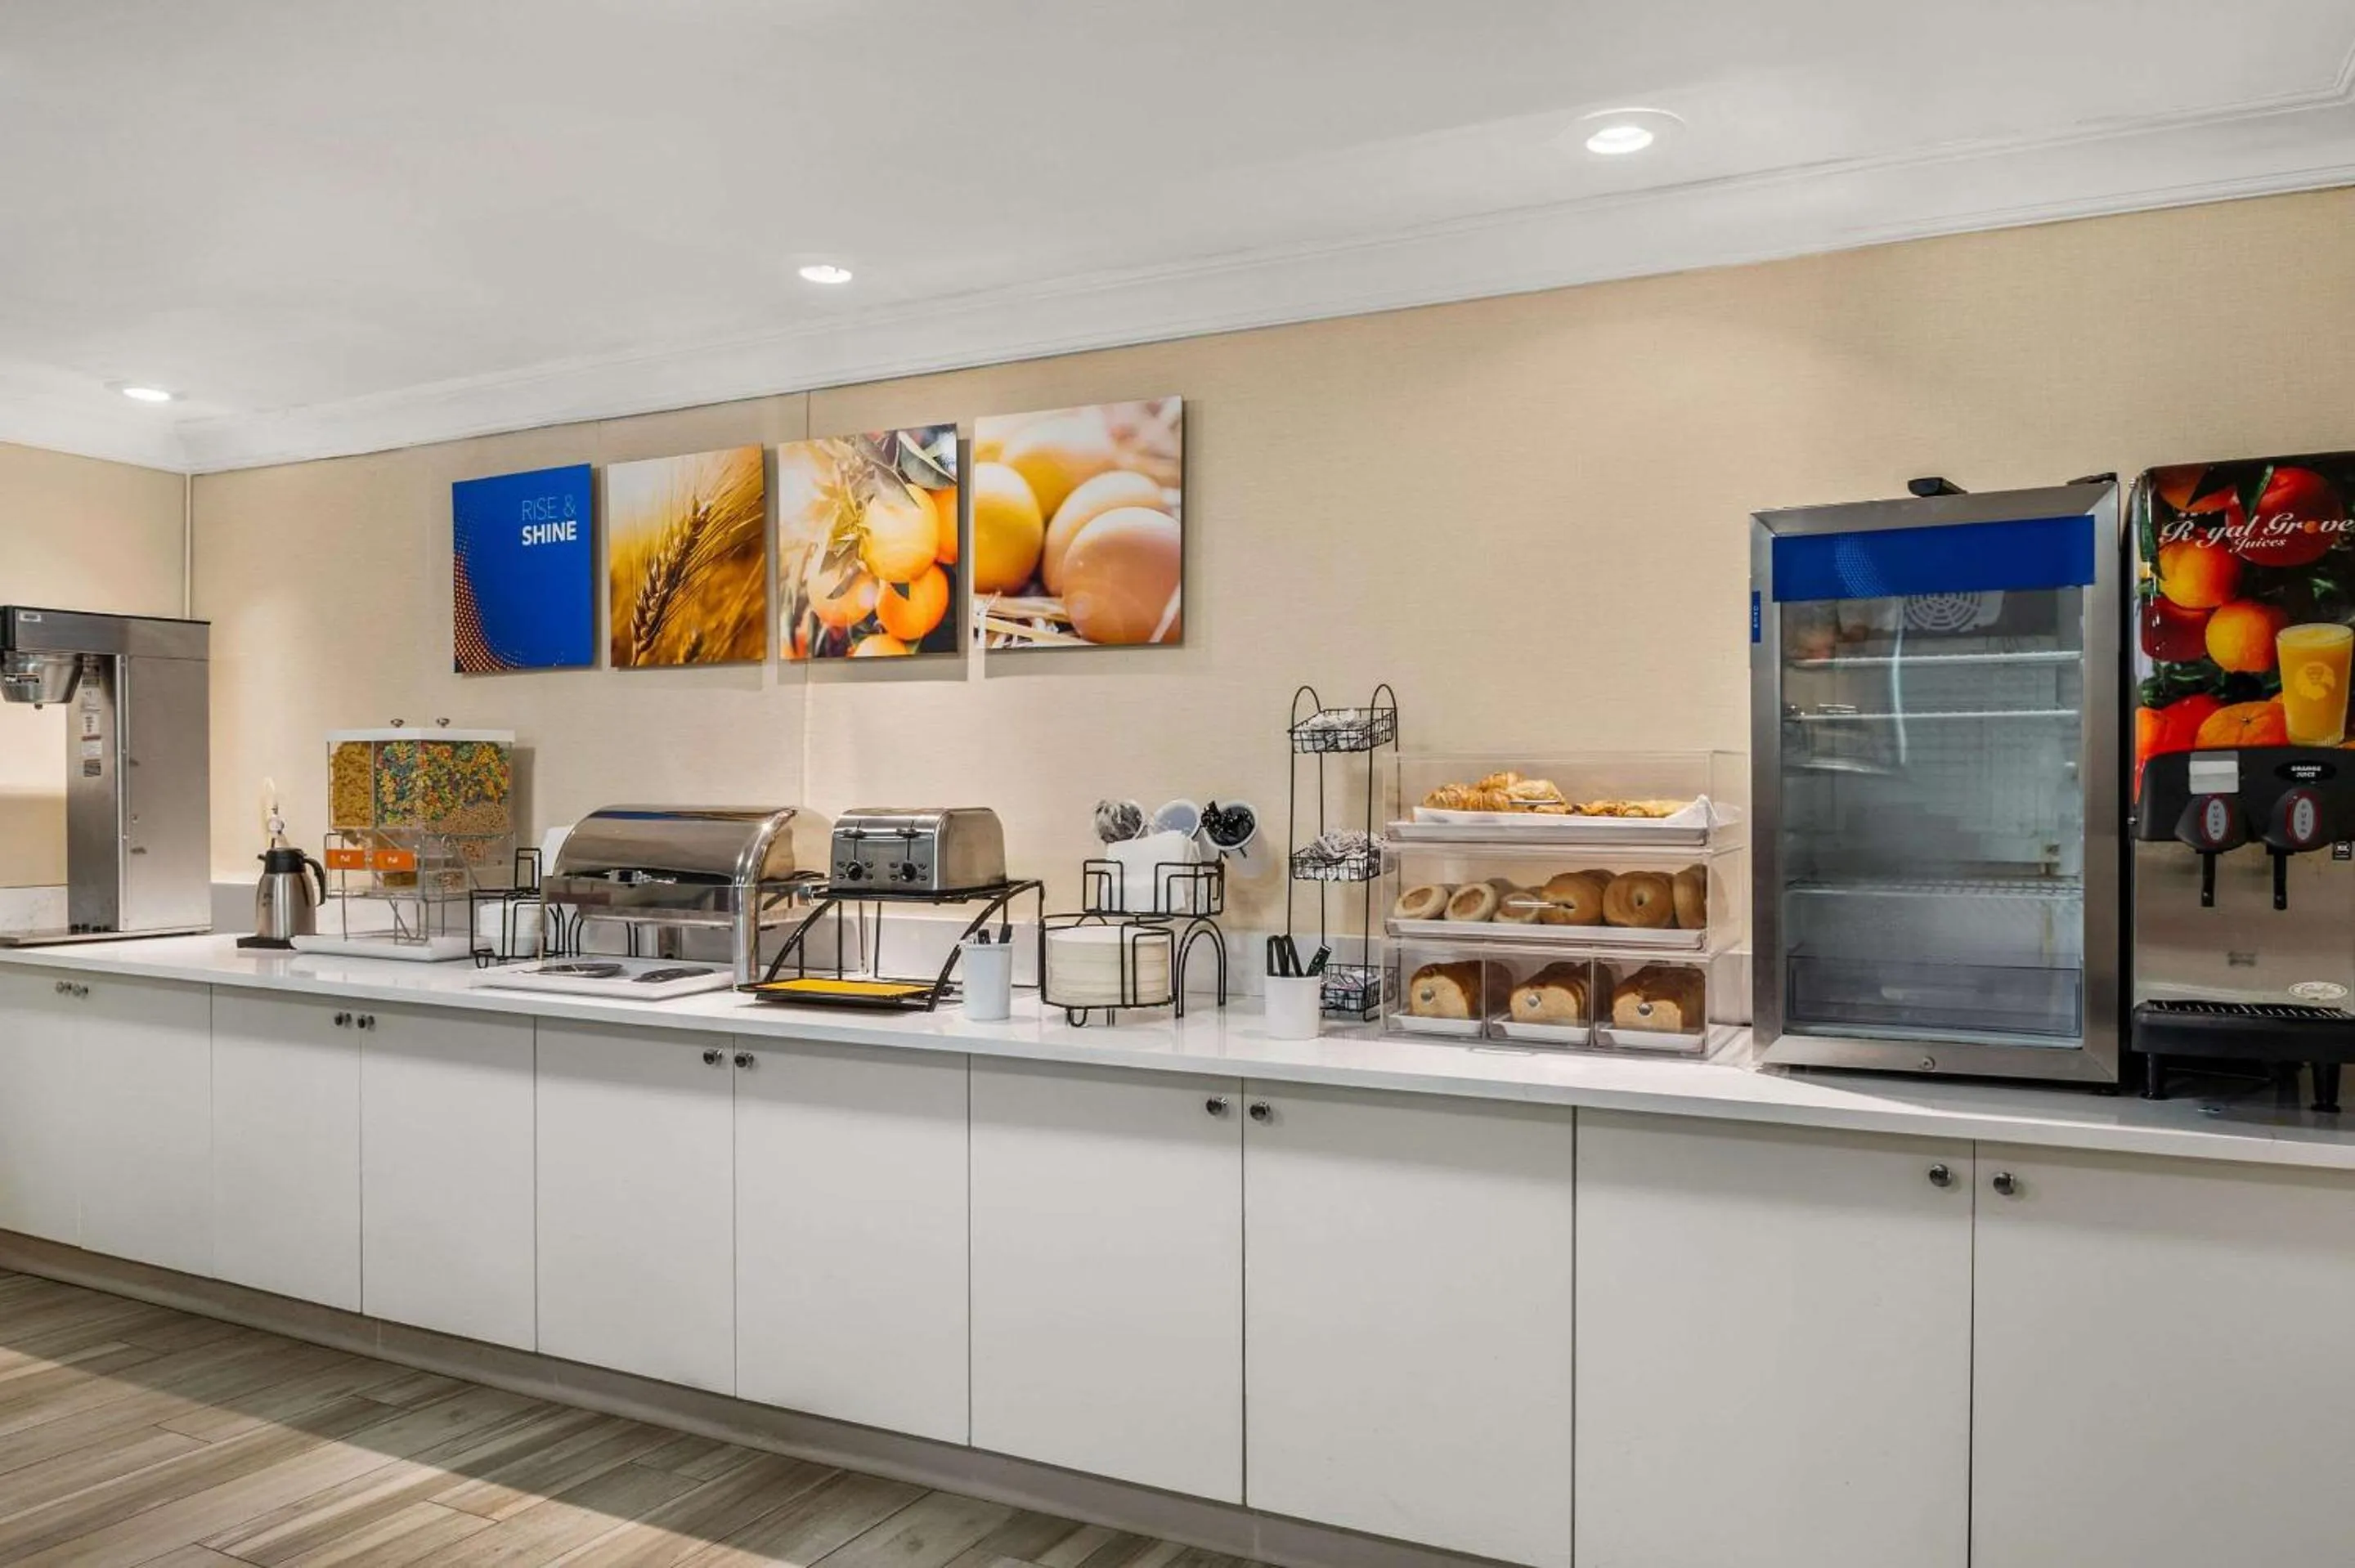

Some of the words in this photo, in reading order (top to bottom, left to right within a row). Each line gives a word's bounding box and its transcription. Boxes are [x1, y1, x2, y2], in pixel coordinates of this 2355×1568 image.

[522, 496, 558, 522] RISE
[563, 494, 576, 517] &
[522, 520, 577, 545] SHINE
[2159, 515, 2260, 549] Royal
[2263, 513, 2355, 535] Grove
